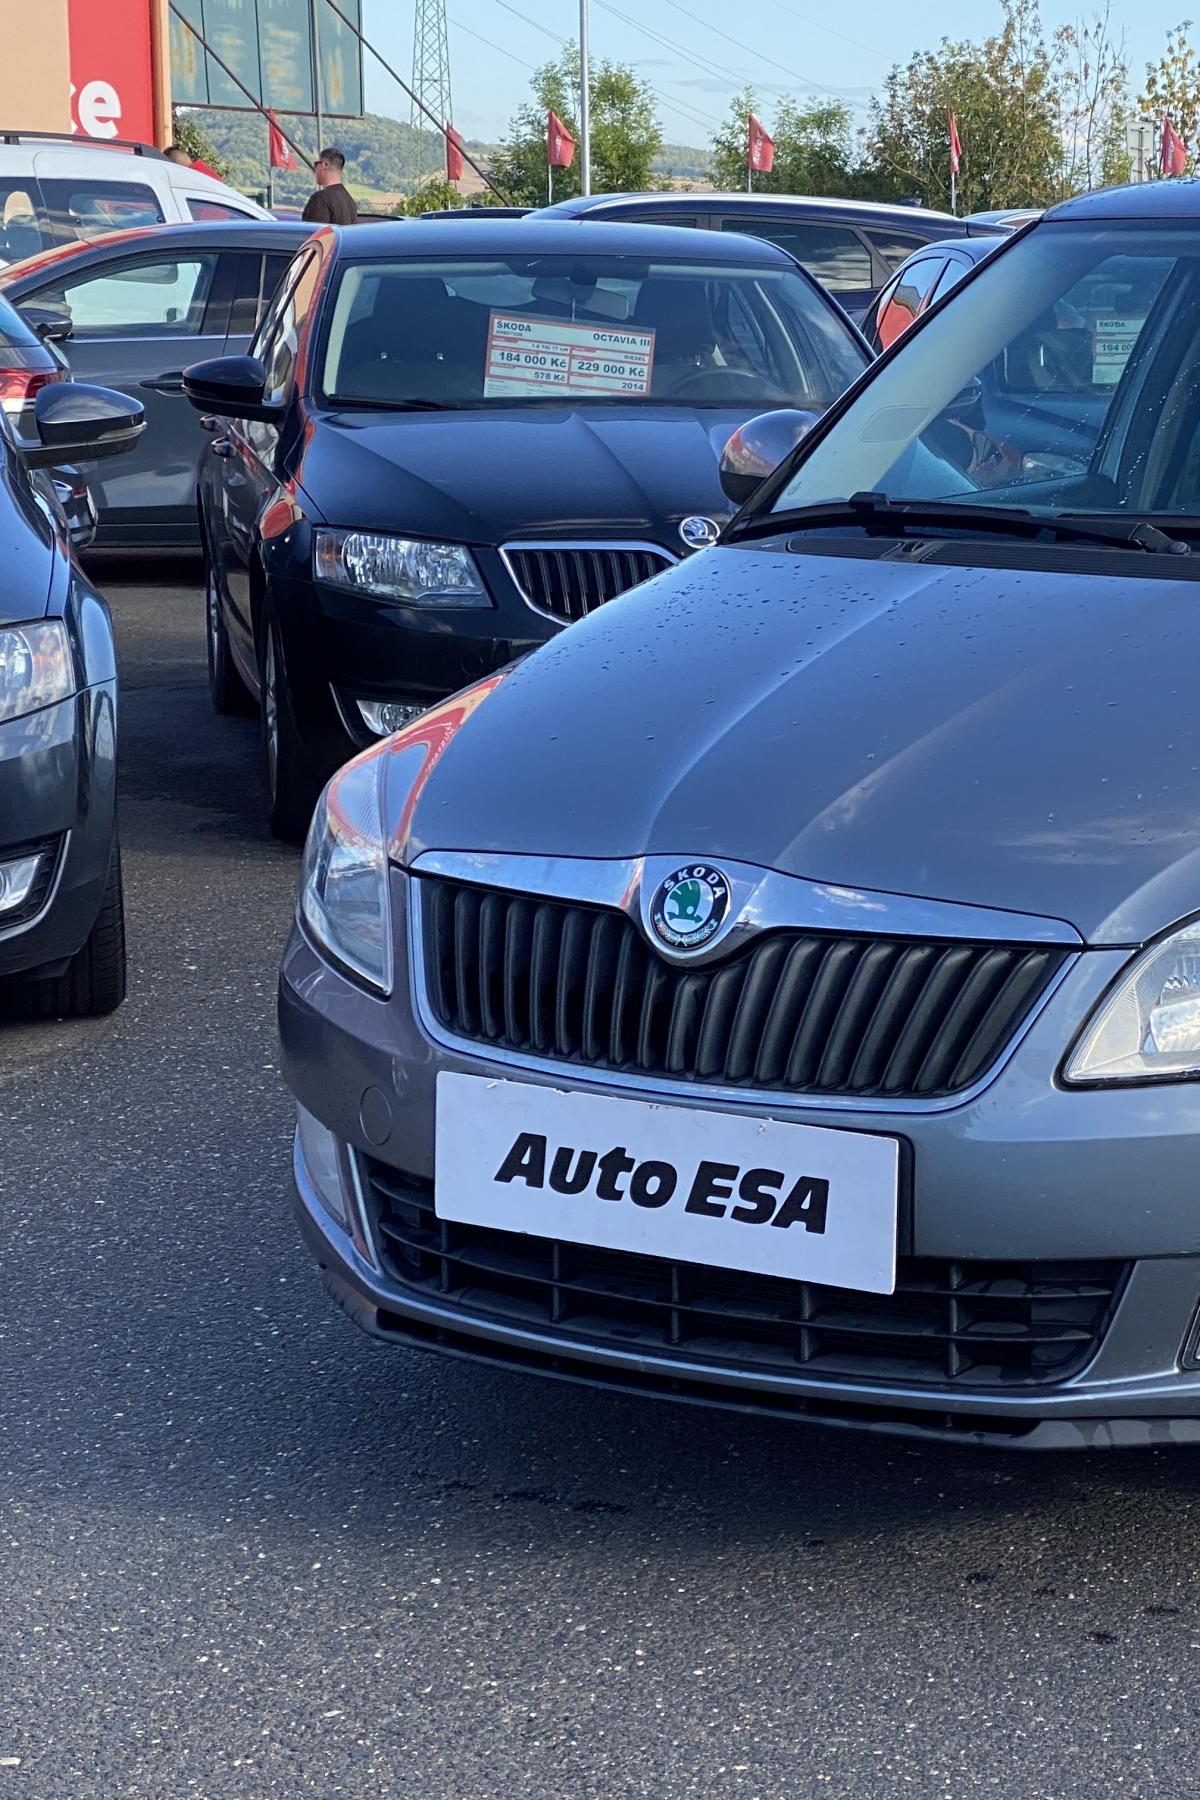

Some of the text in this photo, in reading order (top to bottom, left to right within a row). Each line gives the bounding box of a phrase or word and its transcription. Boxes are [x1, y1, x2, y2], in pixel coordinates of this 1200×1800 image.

[593, 333, 637, 346] OCTAVIA
[499, 351, 521, 362] 184
[524, 355, 547, 366] 000
[551, 358, 567, 368] Kč
[624, 354, 646, 362] DIESEL
[578, 361, 645, 377] 229 000 Kč
[534, 371, 551, 380] 578
[553, 374, 566, 382] Kč
[622, 382, 644, 391] 2014
[493, 1131, 830, 1235] Auto ESA
